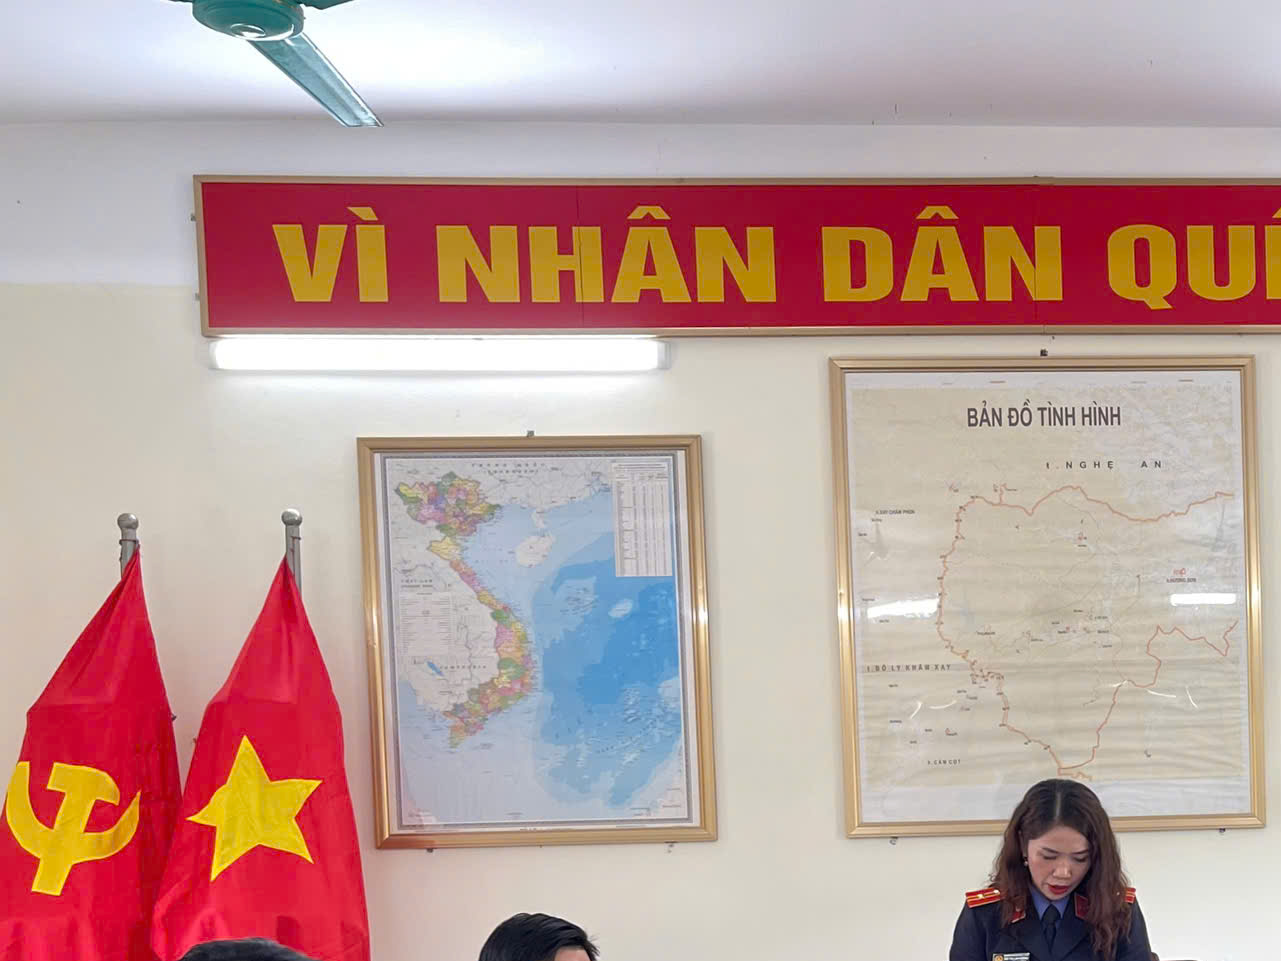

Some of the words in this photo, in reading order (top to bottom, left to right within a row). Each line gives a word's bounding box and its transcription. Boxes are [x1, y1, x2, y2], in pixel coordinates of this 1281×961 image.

[272, 206, 388, 302] VÌ
[436, 205, 777, 303] NHÂN
[821, 205, 1062, 301] DÂN
[967, 400, 1003, 427] BẢN
[1008, 399, 1033, 427] ĐỒ
[1037, 401, 1076, 427] TÌNH
[1081, 401, 1121, 426] HÌNH
[1141, 460, 1162, 469] AN
